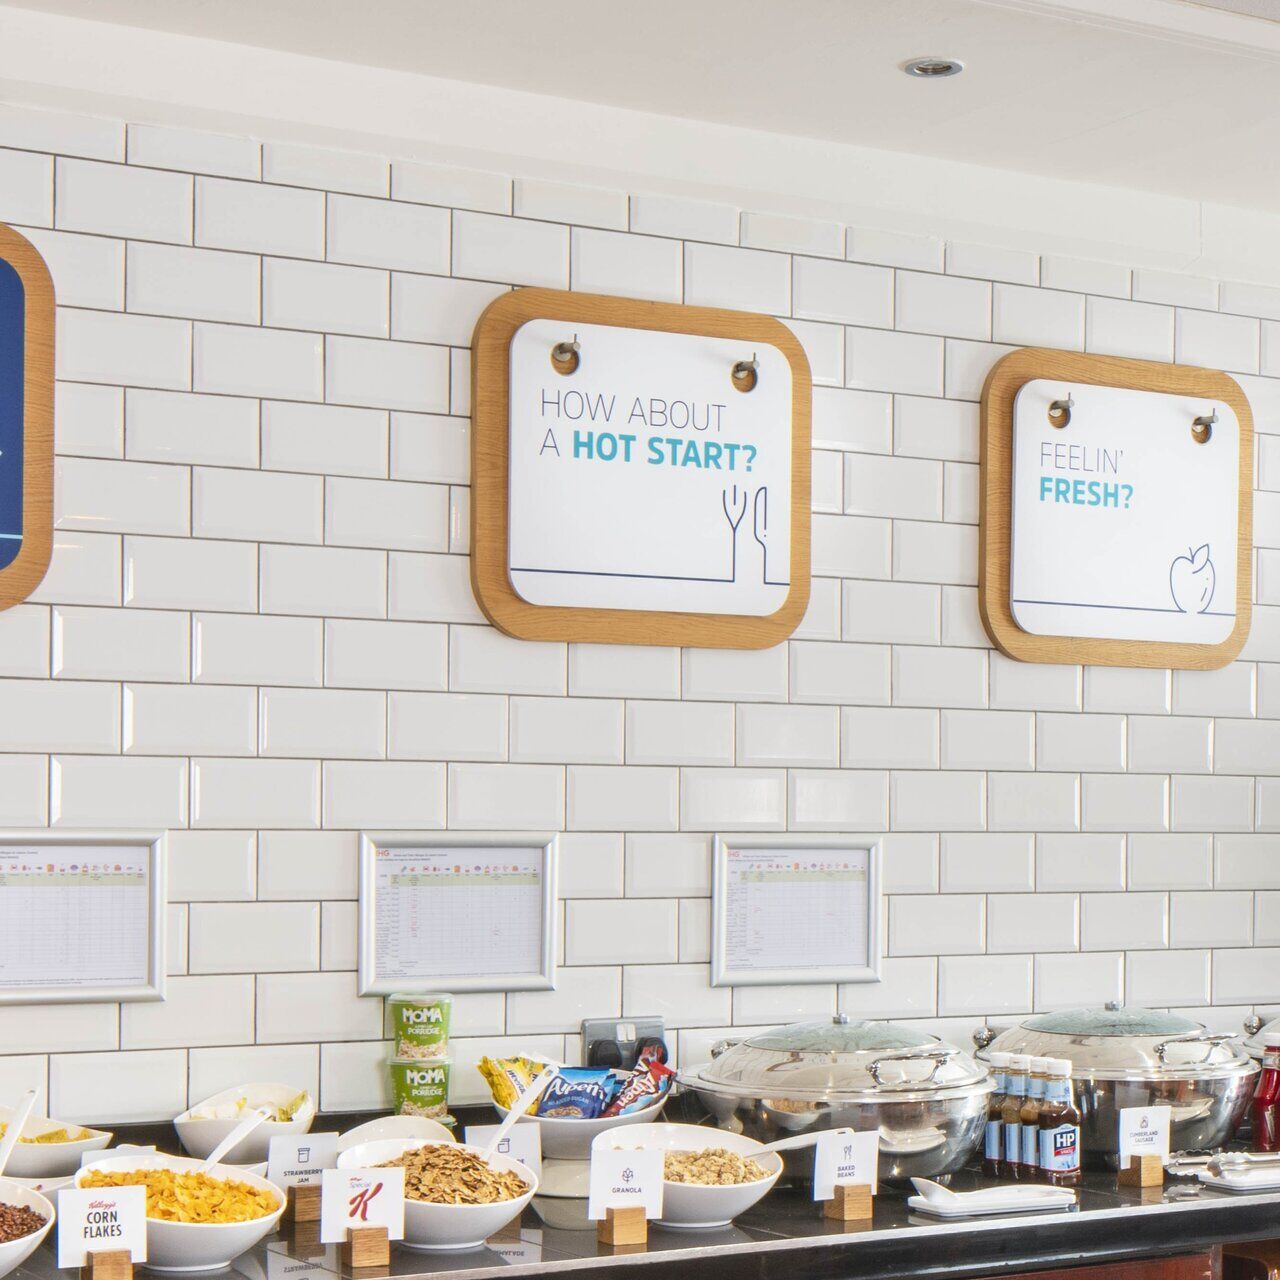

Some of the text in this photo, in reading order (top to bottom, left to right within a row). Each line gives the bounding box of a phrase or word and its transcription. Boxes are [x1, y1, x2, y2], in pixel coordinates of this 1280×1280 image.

[541, 388, 727, 432] HOW ABOUT
[539, 428, 758, 473] A HOT START?
[1040, 441, 1123, 475] FEELIN'
[1039, 476, 1134, 509] FRESH?
[402, 1007, 443, 1024] MOMA
[407, 1027, 440, 1035] PORRIDGE
[406, 1069, 445, 1086] MOMA
[411, 1088, 443, 1096] PORRIDGE
[545, 1077, 602, 1099] Alpen
[1056, 1132, 1075, 1148] HP
[1130, 1130, 1159, 1138] CUMBERLAND
[283, 1168, 322, 1177] STRAWBERRY
[349, 1182, 384, 1222] K
[87, 1211, 118, 1224] CORN
[84, 1224, 122, 1238] FLAKES
